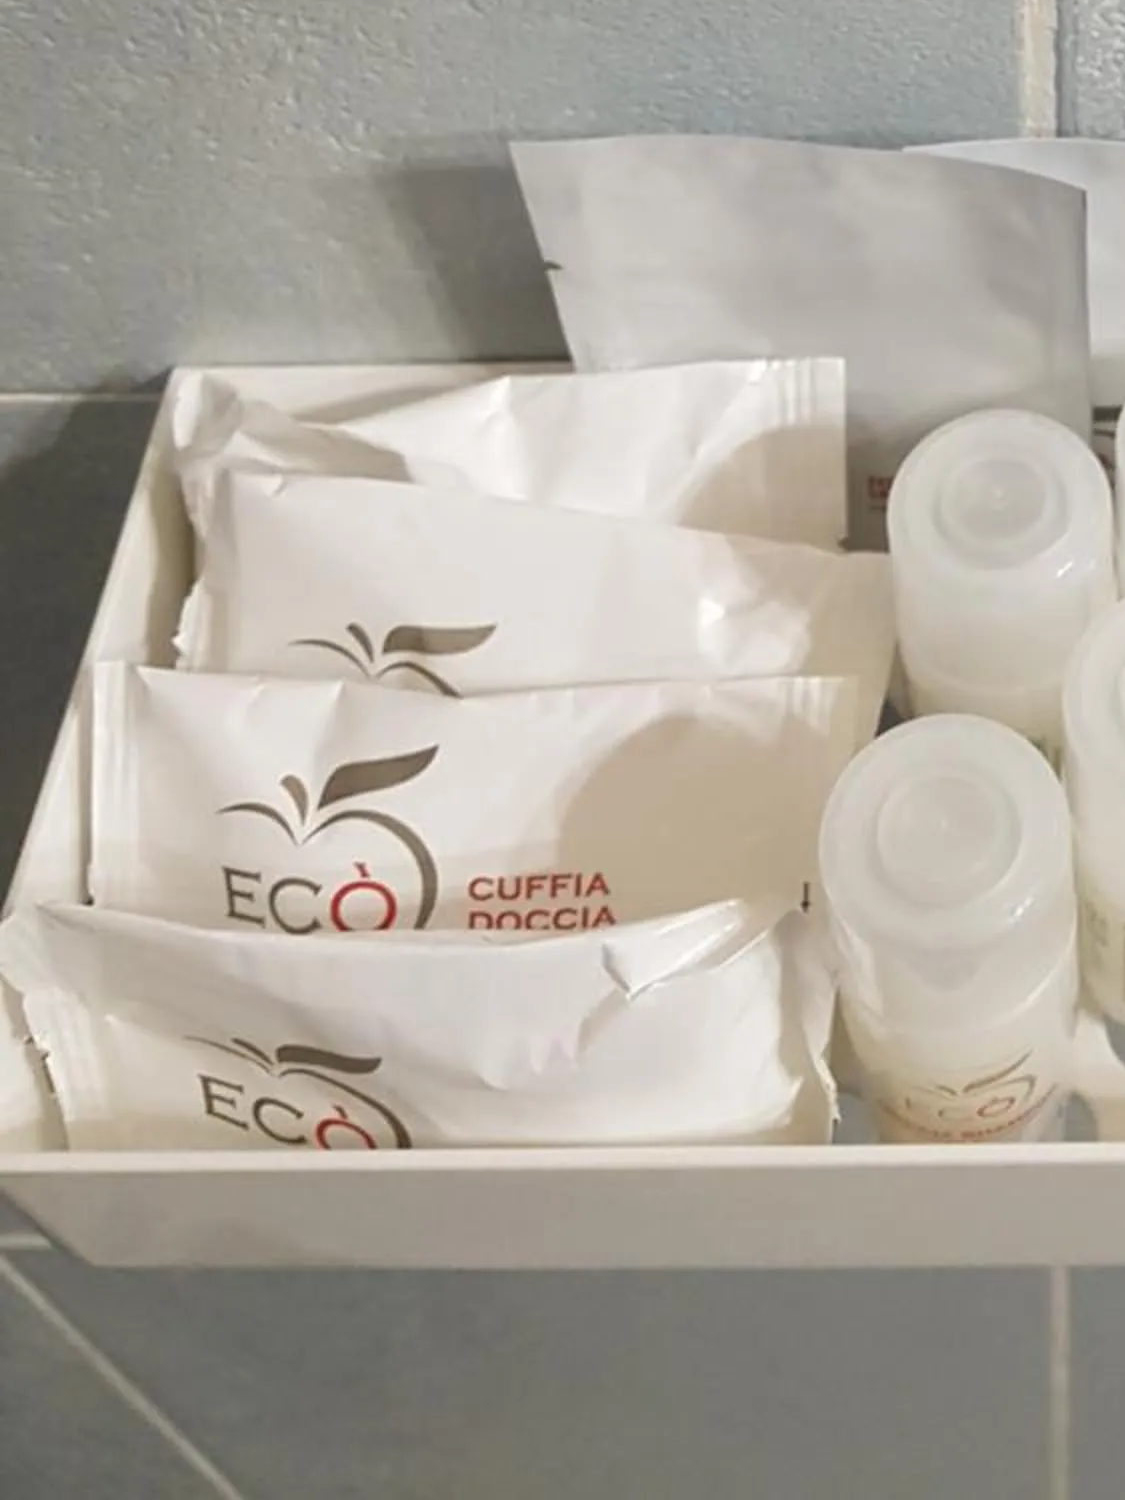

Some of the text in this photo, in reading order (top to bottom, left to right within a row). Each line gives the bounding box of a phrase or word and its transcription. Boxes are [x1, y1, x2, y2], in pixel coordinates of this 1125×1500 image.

[221, 861, 398, 936] ECÒ
[467, 871, 612, 902] CUFFIA
[467, 906, 617, 930] DOCCIA
